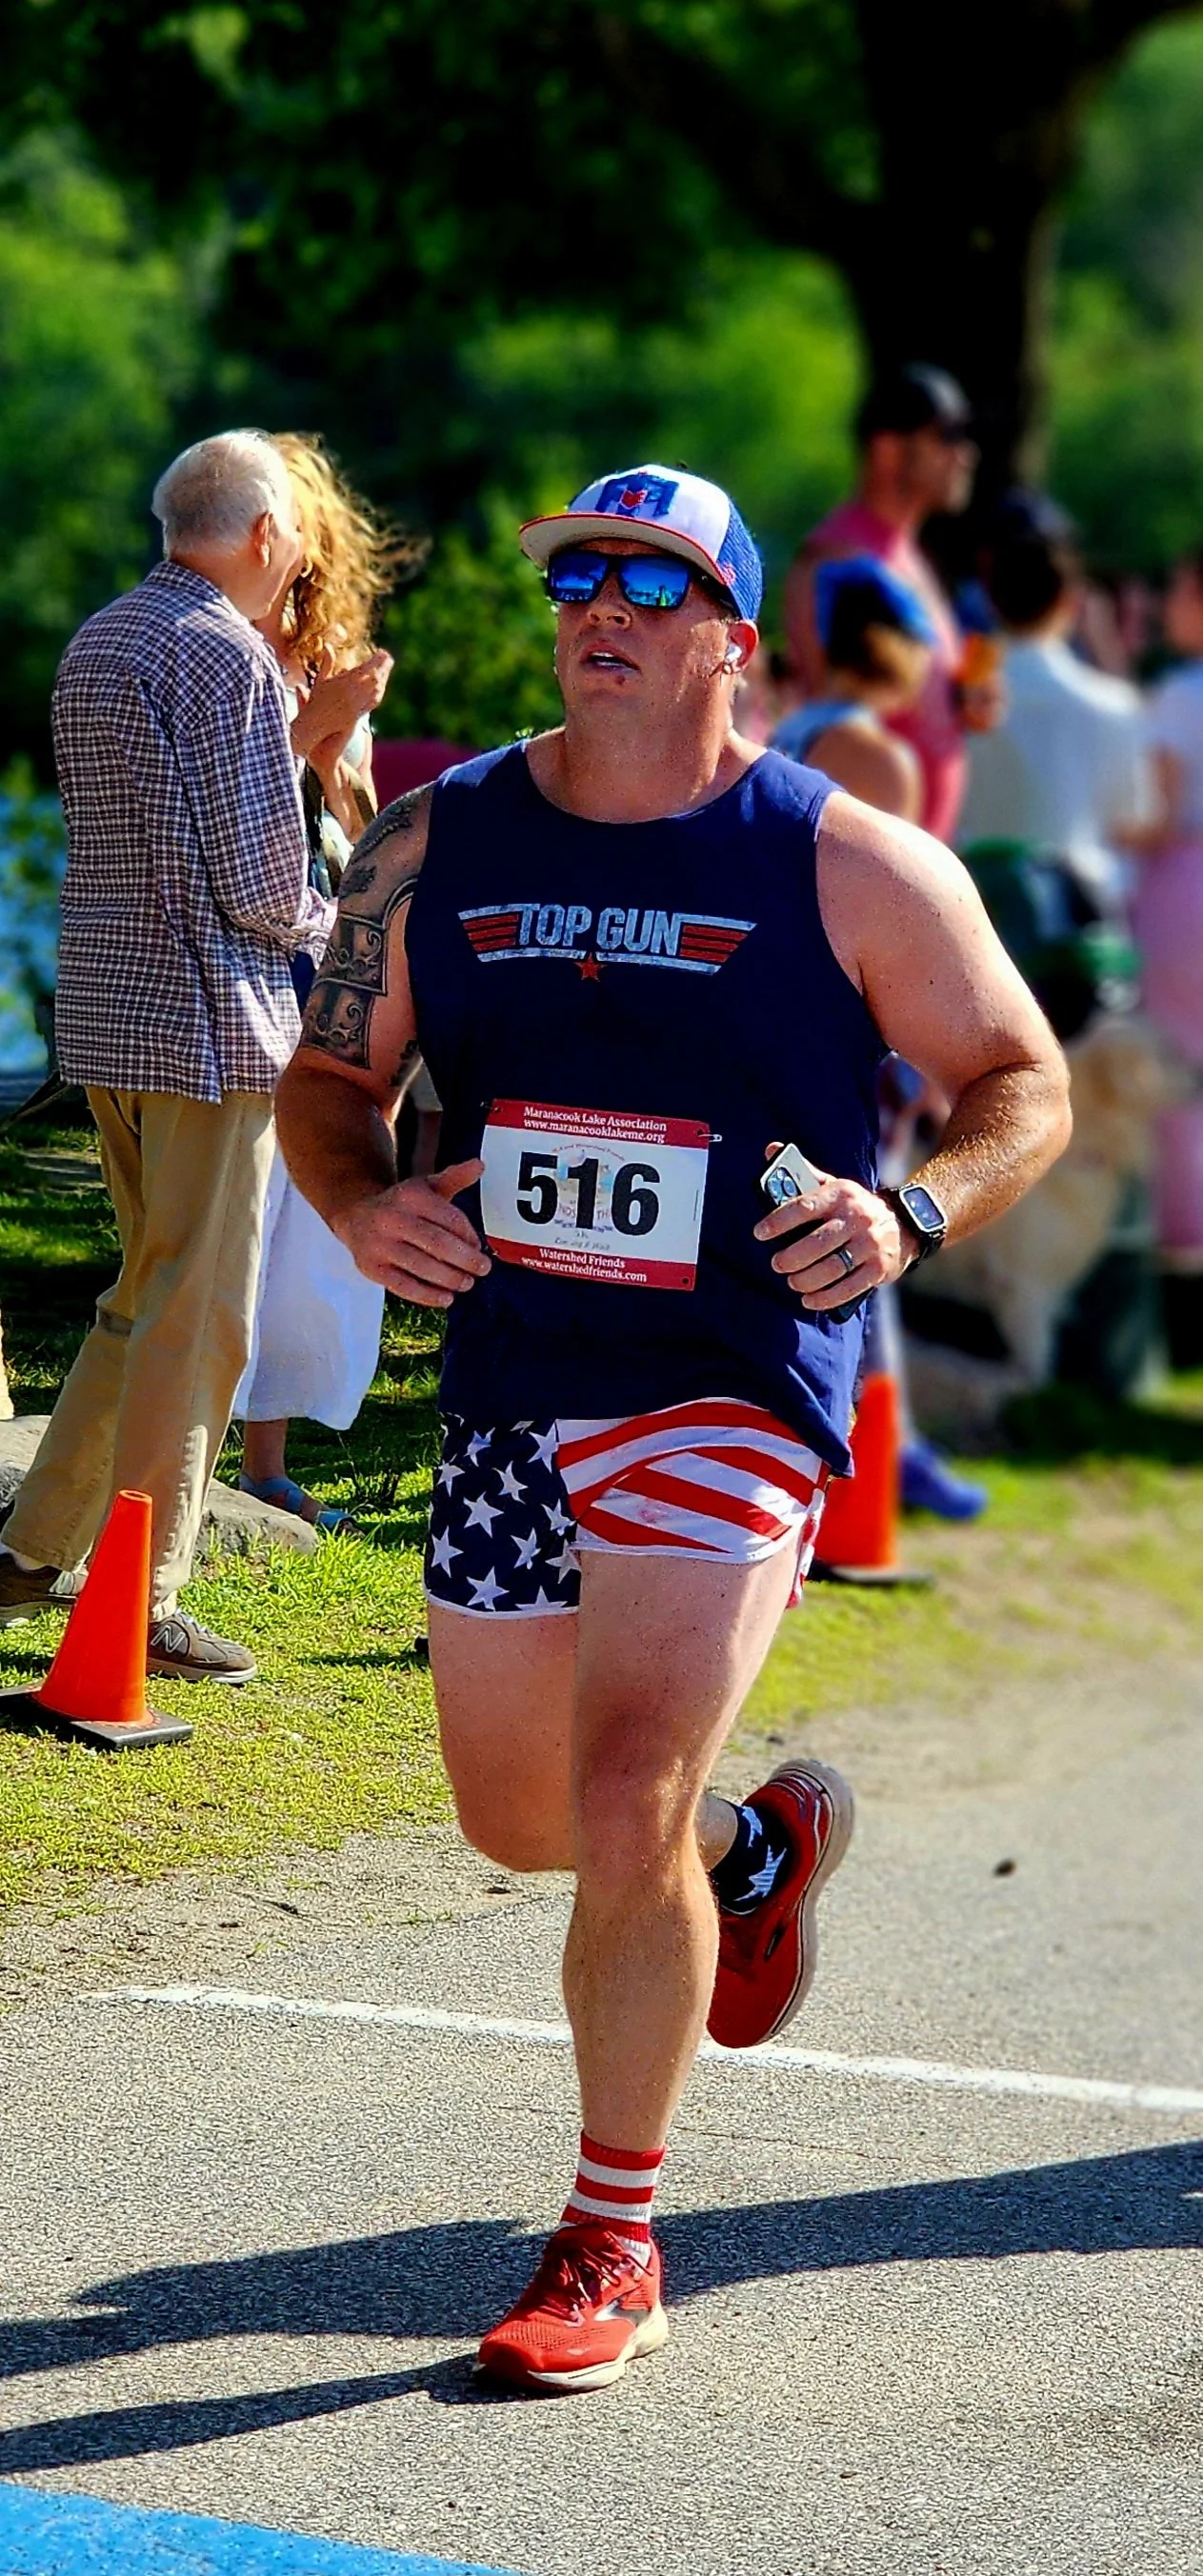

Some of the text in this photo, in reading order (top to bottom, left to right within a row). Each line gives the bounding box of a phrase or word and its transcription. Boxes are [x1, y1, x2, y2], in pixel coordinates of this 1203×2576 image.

[518, 903, 680, 956] TOP GUN
[524, 1106, 667, 1131] Maranacook Lake Association
[524, 1119, 665, 1144] www.maranacooklakeme.org
[516, 1151, 660, 1236] 516
[521, 1256, 648, 1282] www.watershedfriends.com
[539, 1248, 626, 1268] Watershed Friends
[151, 1625, 185, 1654] N
